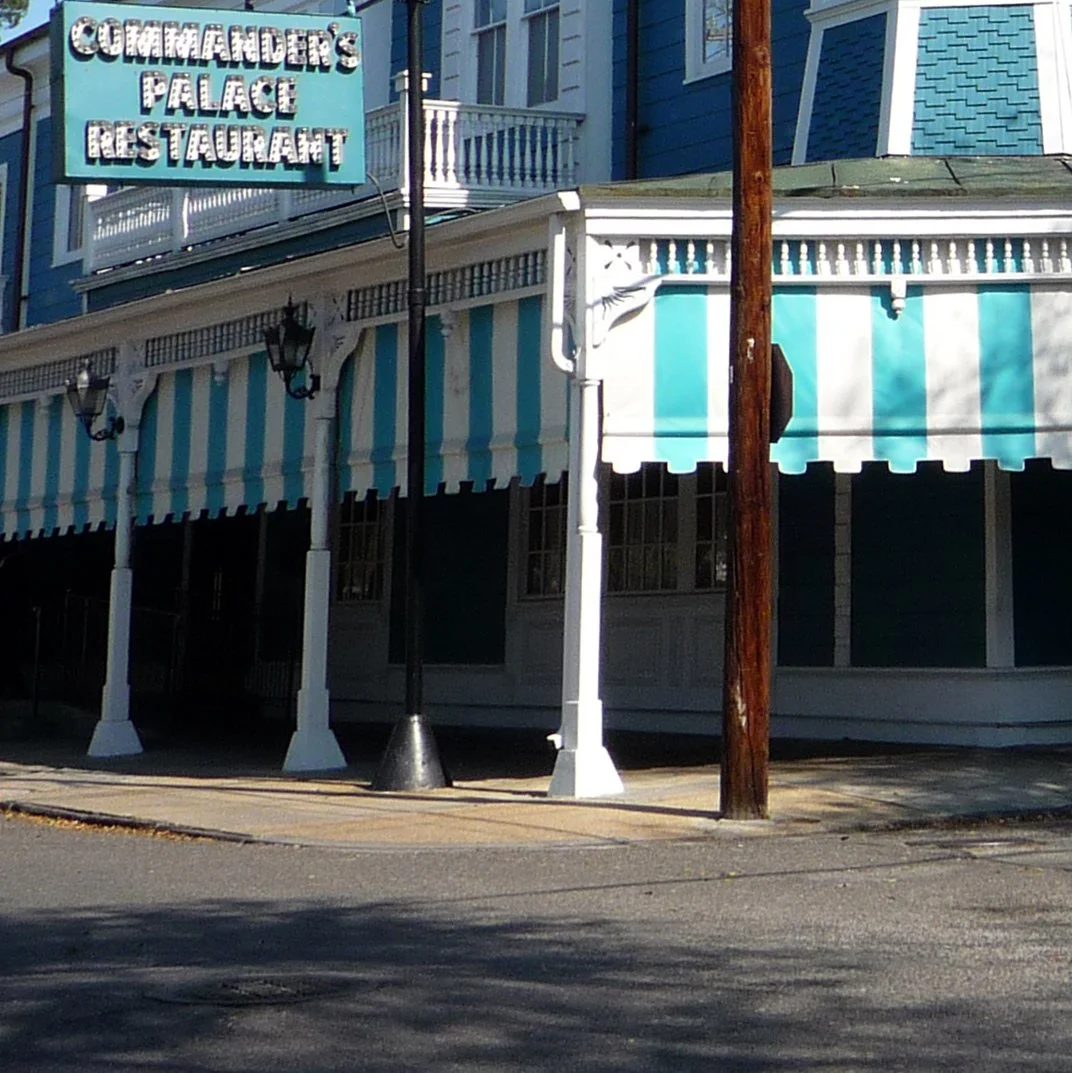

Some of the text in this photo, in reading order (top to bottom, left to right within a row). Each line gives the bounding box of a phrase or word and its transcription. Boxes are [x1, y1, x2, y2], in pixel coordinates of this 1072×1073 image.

[70, 16, 361, 71] COMMANDER'S
[140, 71, 298, 116] PALACE
[86, 120, 348, 167] RESTAURANT
